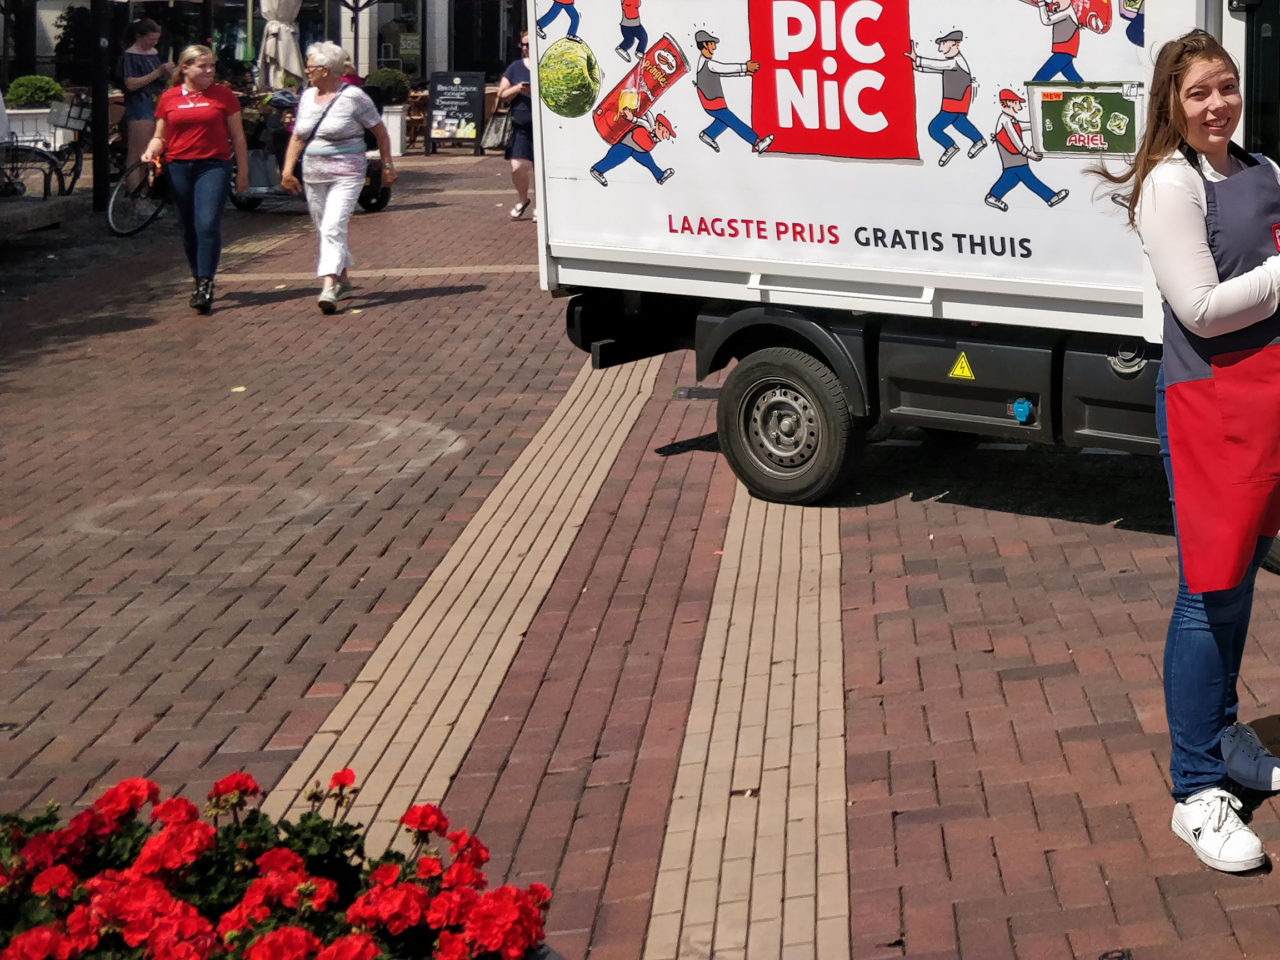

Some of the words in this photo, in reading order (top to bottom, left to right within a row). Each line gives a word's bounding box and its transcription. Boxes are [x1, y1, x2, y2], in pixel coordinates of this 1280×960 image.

[772, 0, 883, 65] PIC
[644, 60, 668, 87] Pringles
[1067, 134, 1107, 146] ARIEL
[667, 214, 768, 241] LAAGSTE
[774, 222, 840, 246] PRIJS
[854, 226, 944, 253] GRATIS
[952, 234, 1032, 260] THUIS
